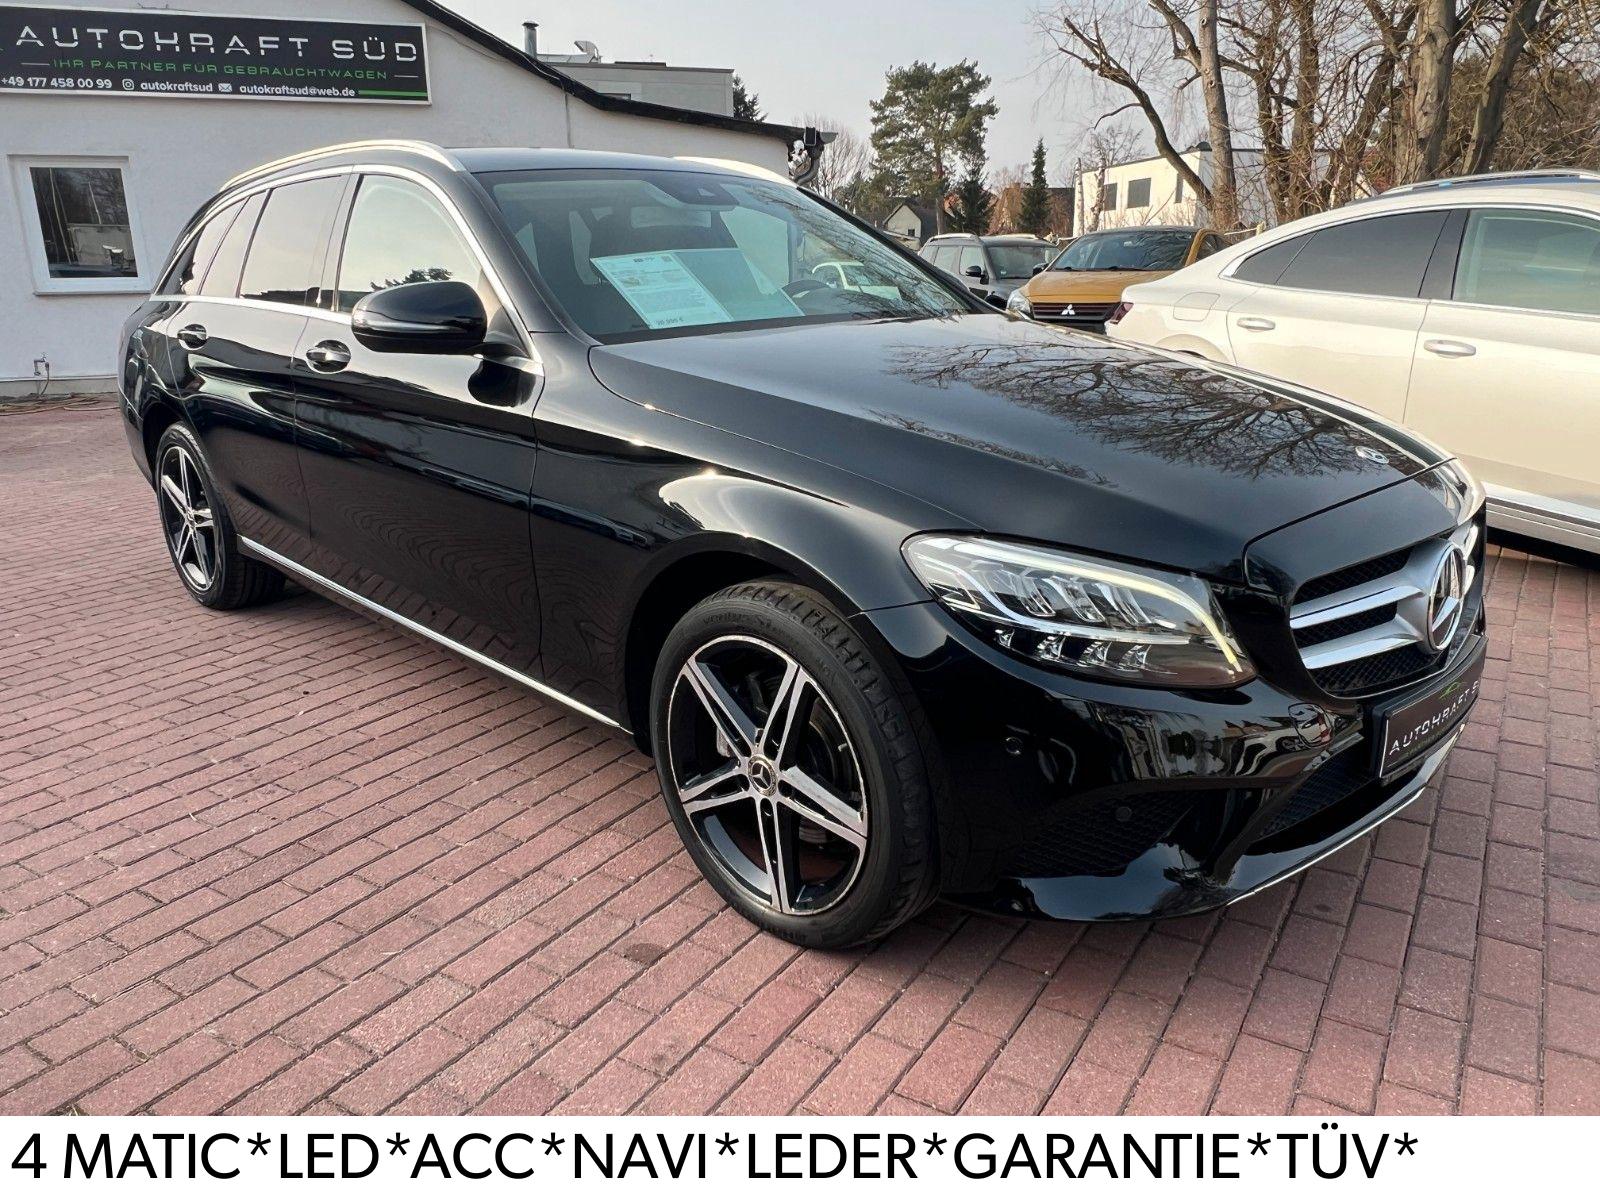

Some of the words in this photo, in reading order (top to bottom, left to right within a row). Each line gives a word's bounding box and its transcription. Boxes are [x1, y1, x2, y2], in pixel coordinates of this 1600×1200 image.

[331, 36, 417, 62] SÜD
[52, 58, 85, 69] IHR
[90, 60, 177, 73] PARTNER
[223, 64, 388, 81] GEBRAUCHTWAGEN
[1, 75, 25, 88] +49
[26, 76, 48, 88] 177
[50, 77, 75, 89] 458
[77, 78, 94, 89] 00
[95, 78, 113, 90] 99
[140, 80, 214, 93] autokraftsud
[238, 83, 356, 98] autokraftsud@web.de
